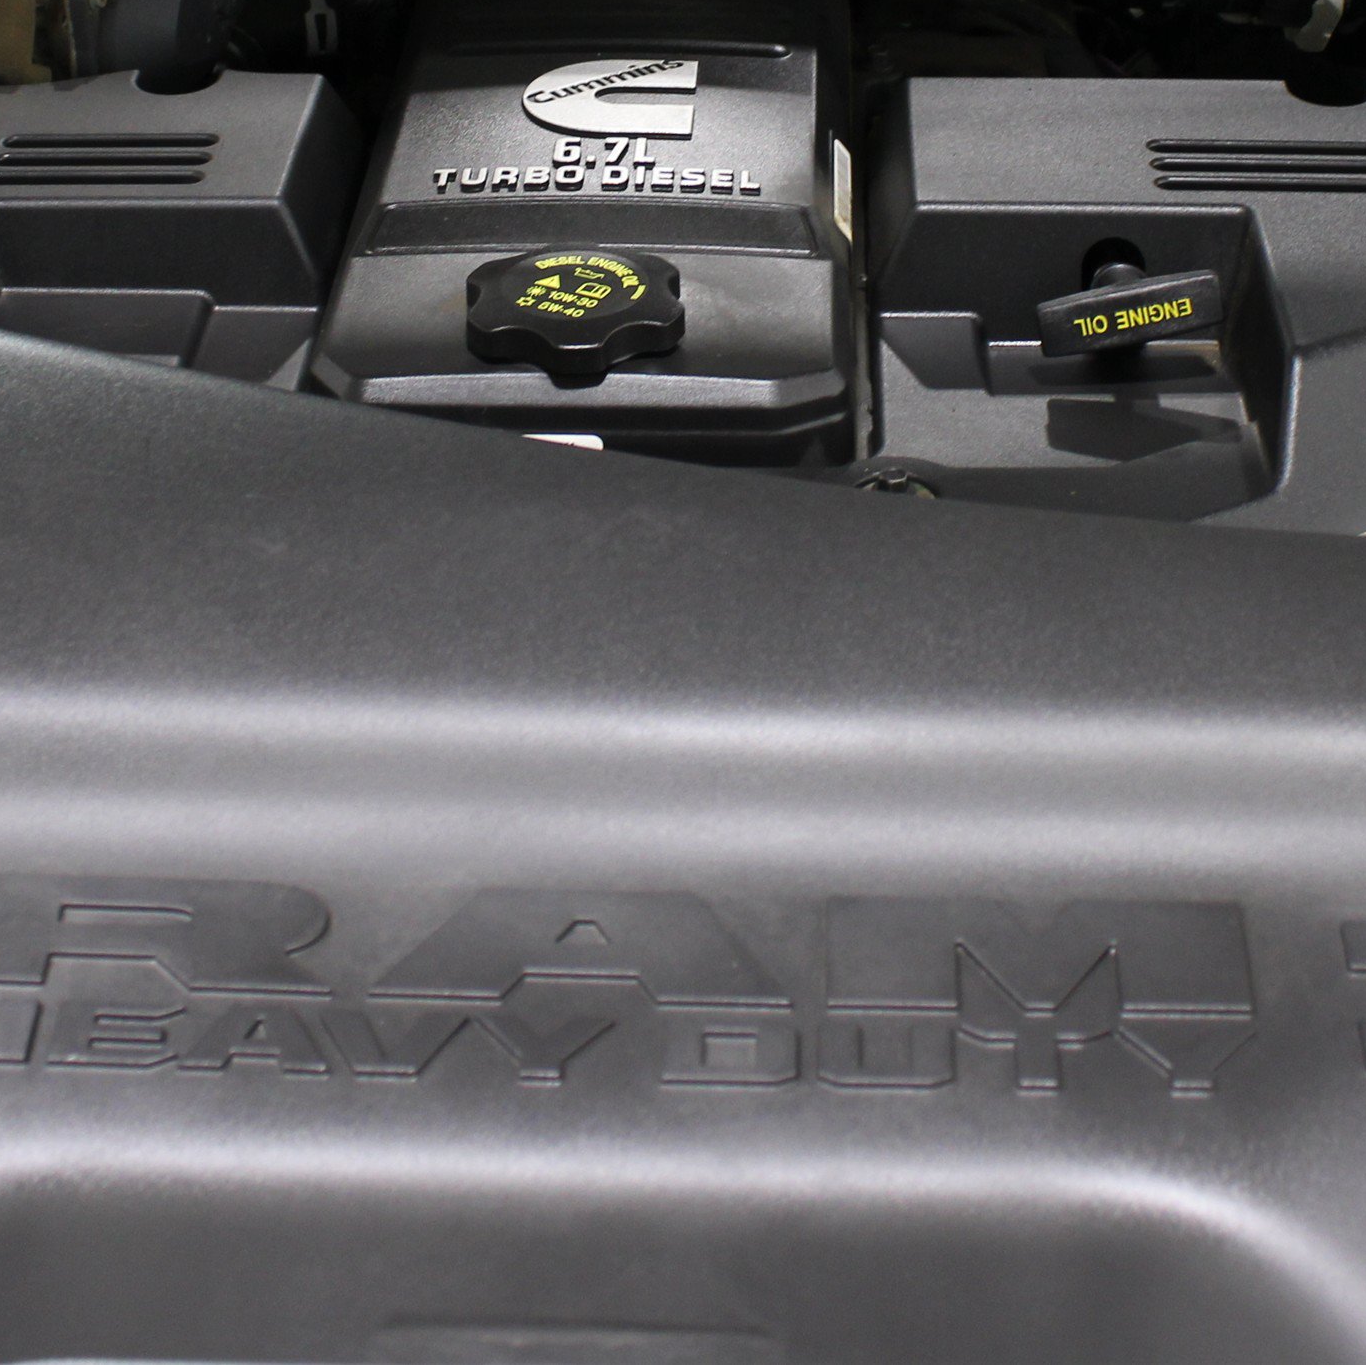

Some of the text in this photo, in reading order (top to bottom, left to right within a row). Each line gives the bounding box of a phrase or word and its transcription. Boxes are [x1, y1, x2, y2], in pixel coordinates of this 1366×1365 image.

[527, 59, 685, 104] Cummins
[553, 137, 656, 168] 6.7L
[433, 165, 762, 195] TURBO DIESEL
[535, 255, 586, 270] DIESEL
[587, 256, 634, 278] ENGINE
[549, 291, 599, 308] 10W-30
[1073, 297, 1194, 337] ENGINE OIL
[659, 1005, 1259, 1097] DUTY
